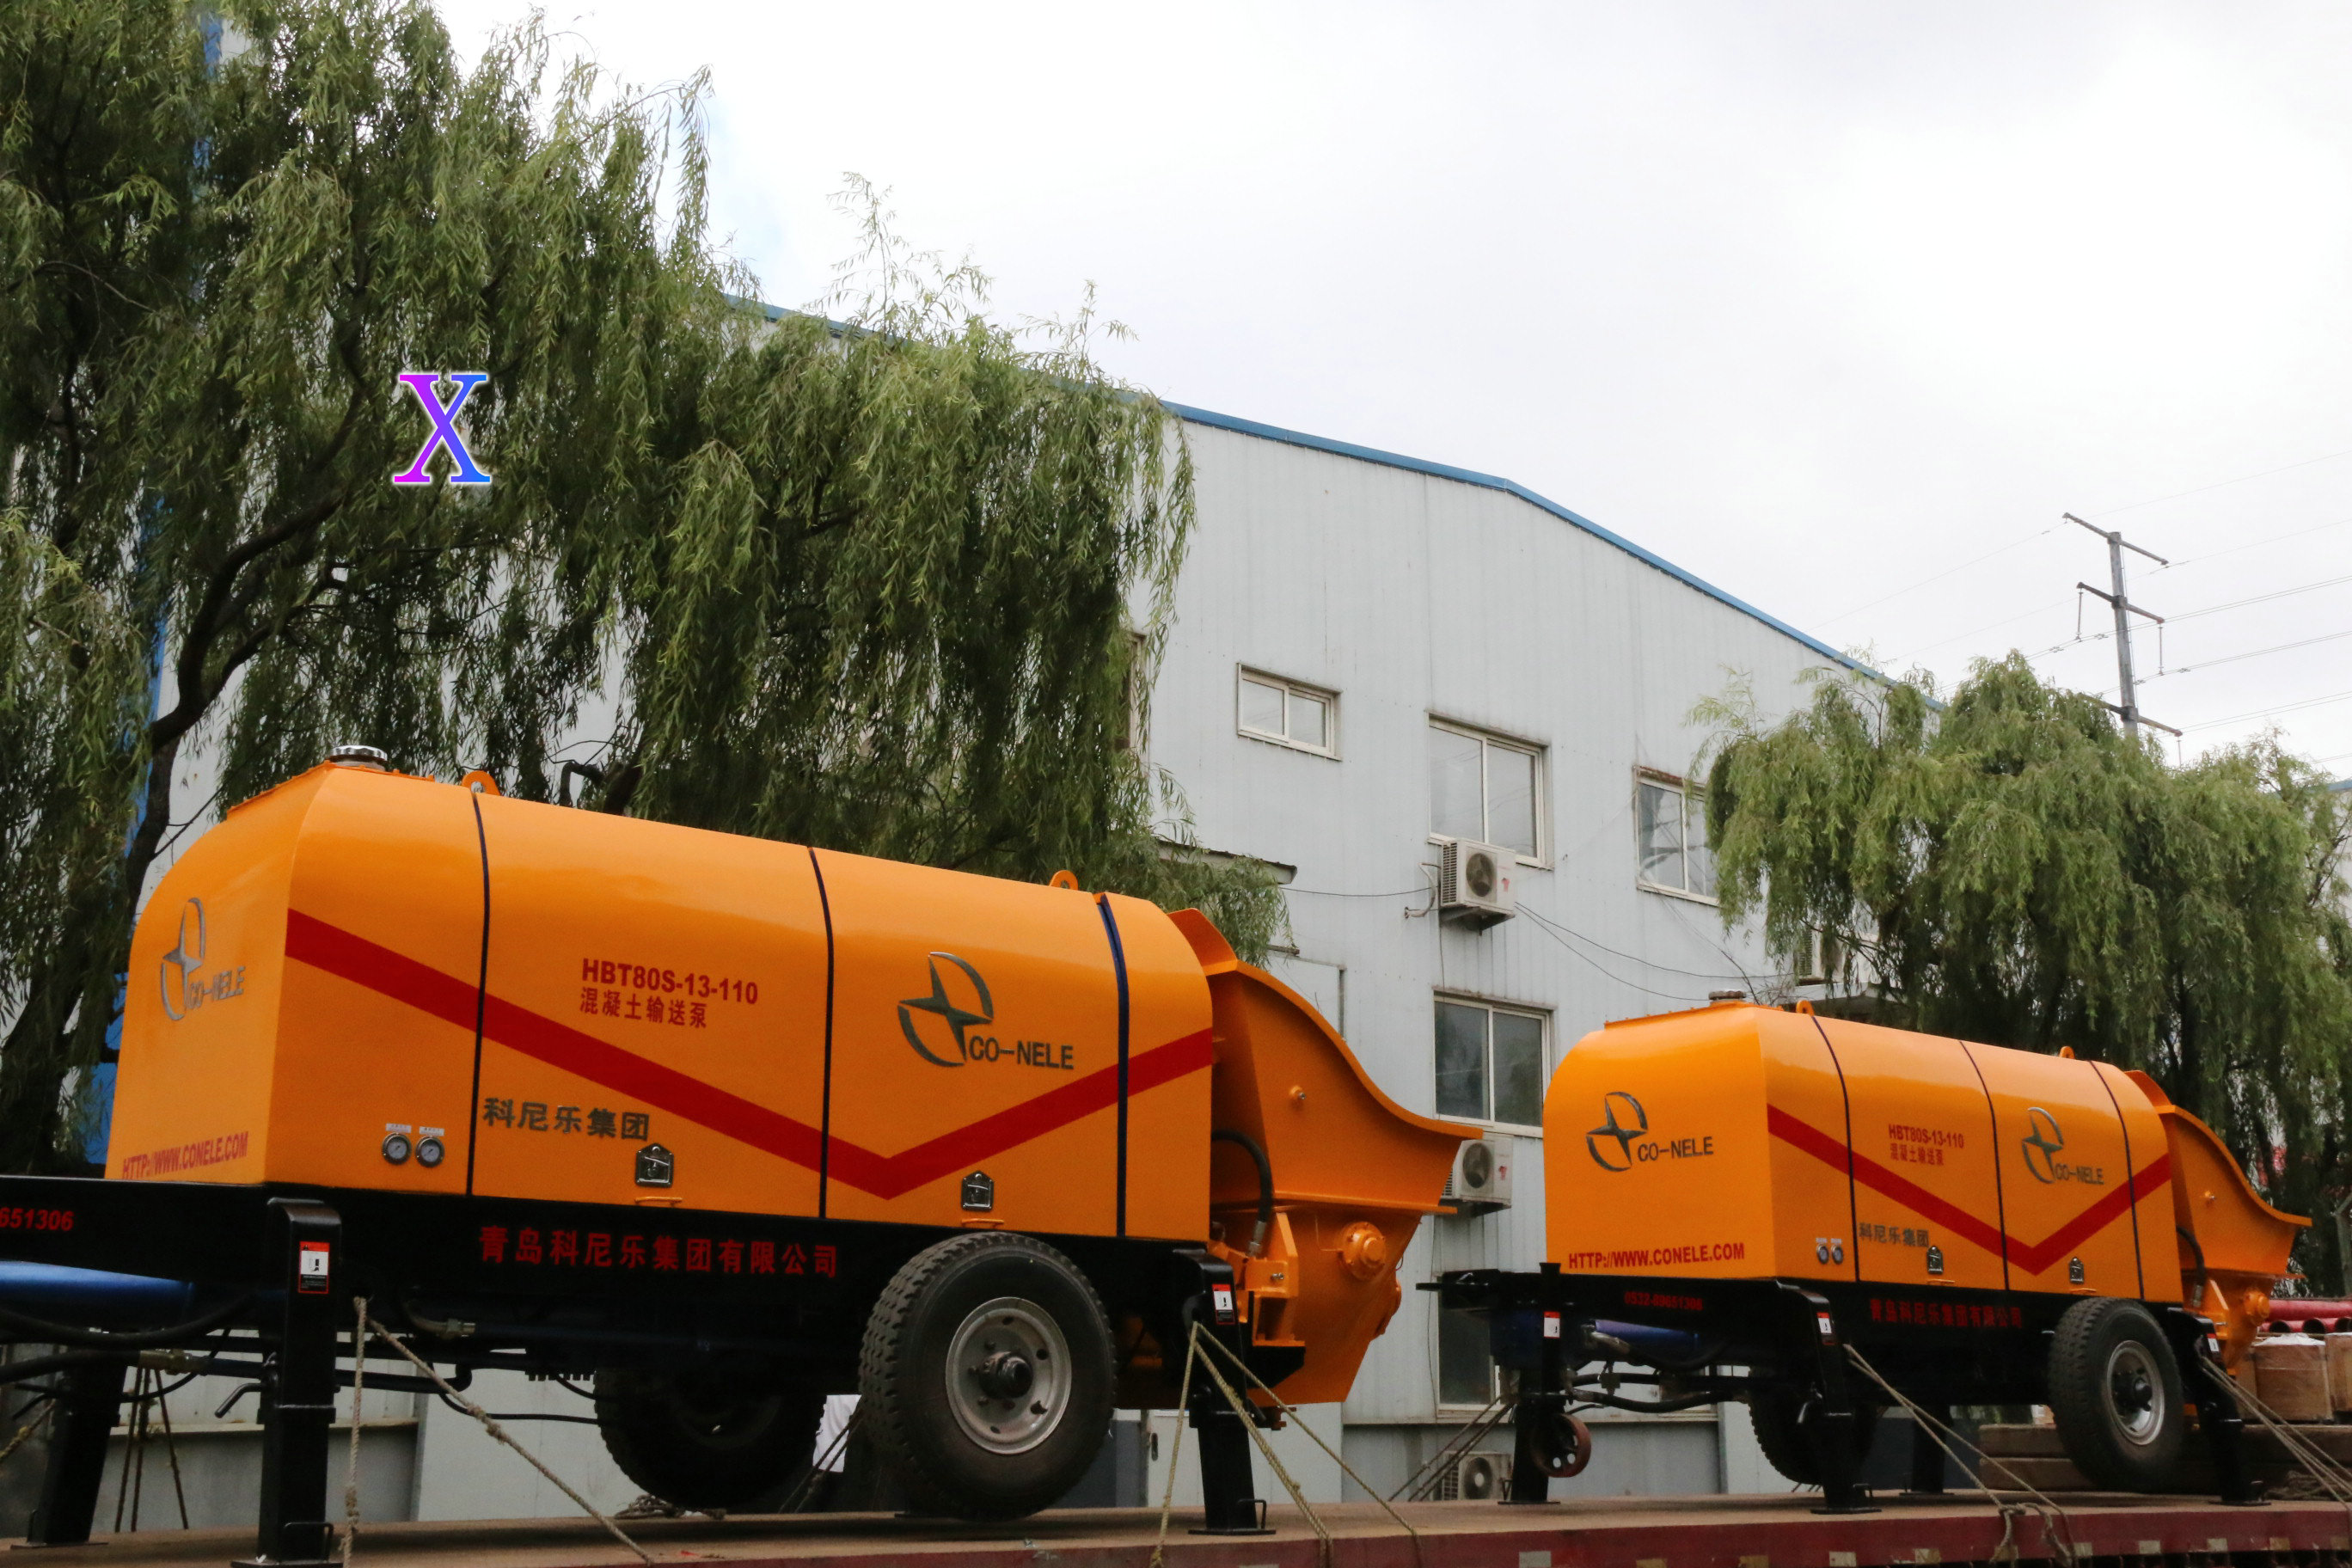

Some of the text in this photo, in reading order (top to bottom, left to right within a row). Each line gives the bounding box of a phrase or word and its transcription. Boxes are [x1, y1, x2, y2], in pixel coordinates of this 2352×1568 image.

[187, 965, 245, 1009] CO-NELE
[581, 958, 758, 1005] HBT80S-13-110
[579, 986, 707, 1029] 混凝土输送泵
[969, 1035, 1074, 1070] CO-NELE
[482, 1097, 650, 1142] 科尼乐集团
[1888, 1123, 1964, 1149] HBT80S-13-110
[1638, 1136, 1714, 1162] CO-NELE
[0, 1207, 75, 1232] 651306
[479, 1225, 838, 1278] 青岛科尼乐集团有限公司
[1568, 1242, 1745, 1270] HTTP://WWW.CONELE.COM
